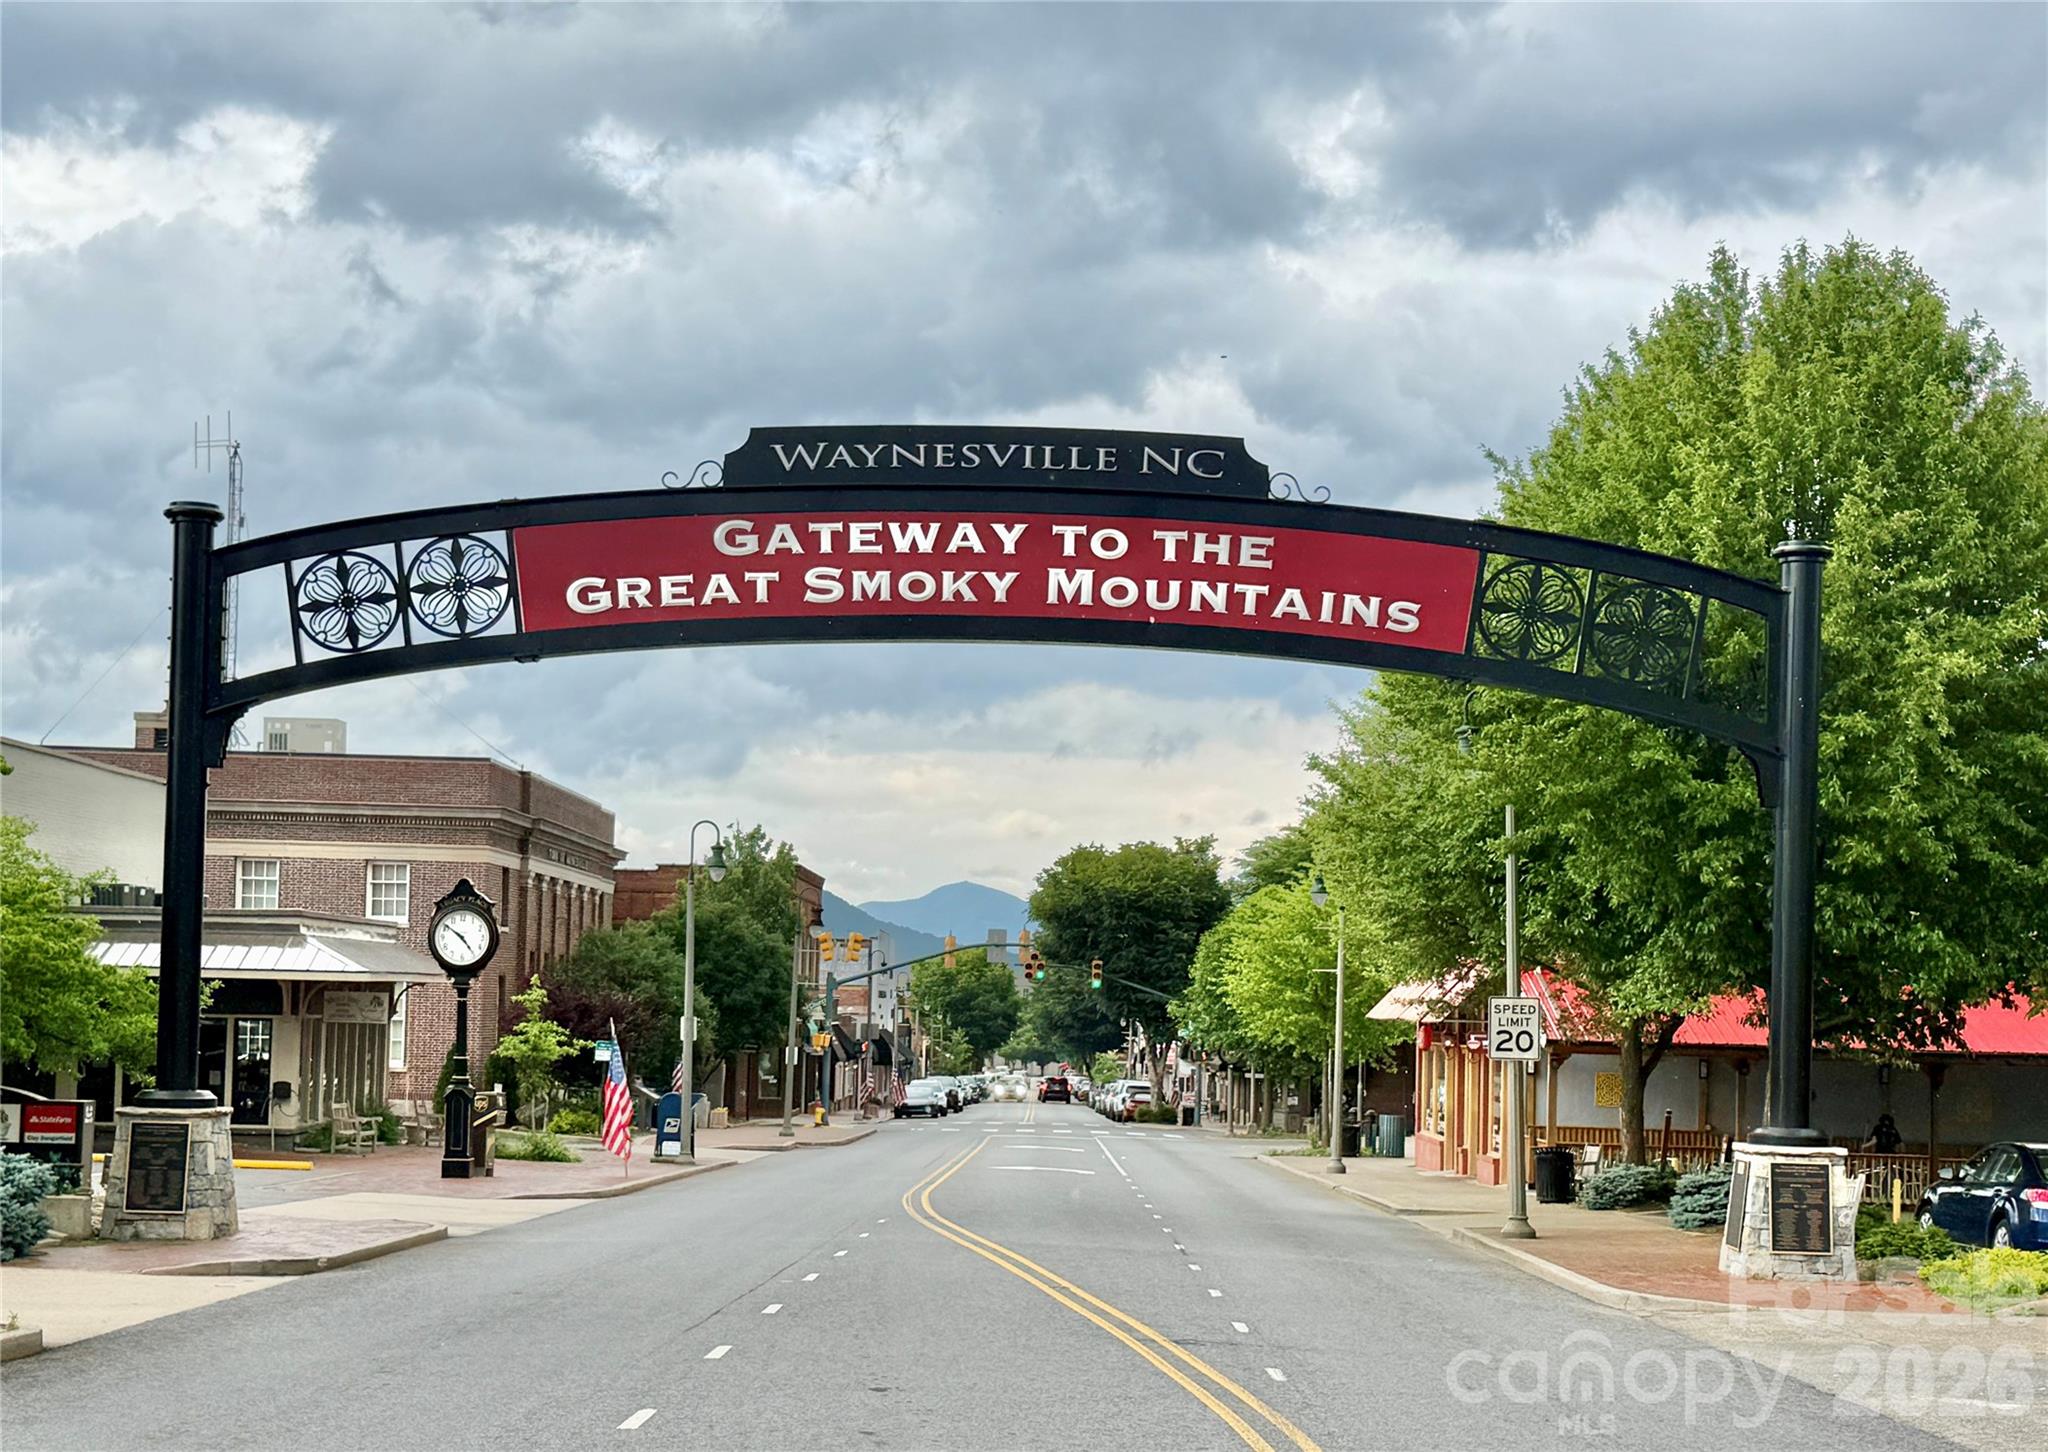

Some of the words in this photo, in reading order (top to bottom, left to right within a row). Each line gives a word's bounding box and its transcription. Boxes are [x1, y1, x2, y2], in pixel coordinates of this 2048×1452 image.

[769, 442, 1118, 473] WAYNESVILLE
[1139, 446, 1227, 480] NC
[713, 519, 1029, 557] GATEWAY
[1052, 524, 1130, 560] TO
[1153, 529, 1276, 570] THE
[566, 570, 780, 615] GREAT
[803, 566, 1021, 604] SMOKY
[1046, 567, 1423, 634] MOUNTAINS
[1494, 1004, 1536, 1015] SPEED
[1498, 1017, 1532, 1027] LIMIT
[1495, 1030, 1534, 1053] 20
